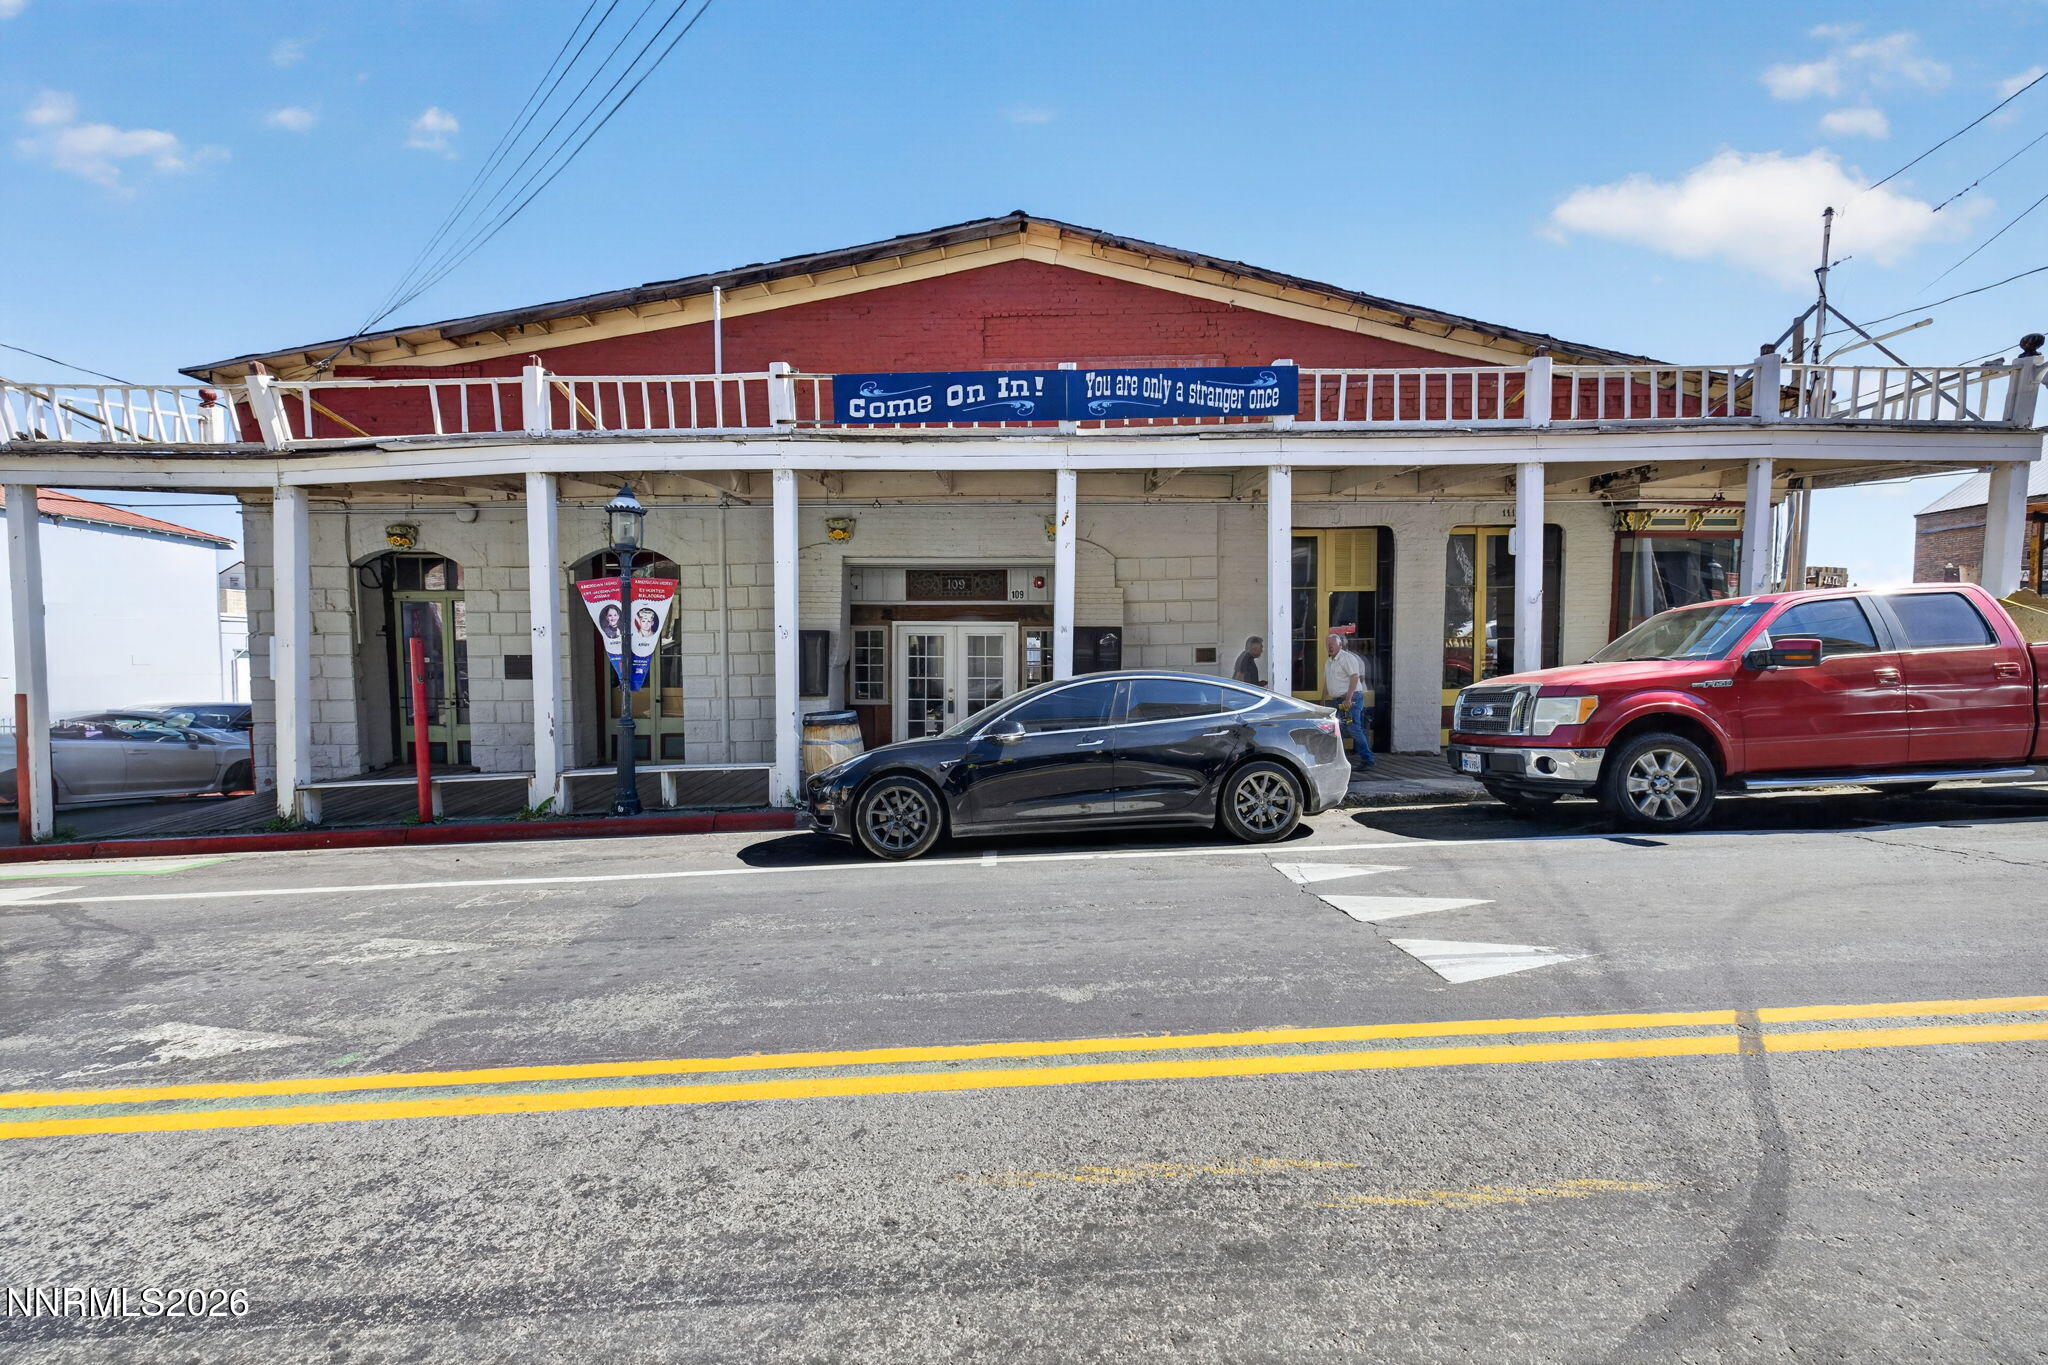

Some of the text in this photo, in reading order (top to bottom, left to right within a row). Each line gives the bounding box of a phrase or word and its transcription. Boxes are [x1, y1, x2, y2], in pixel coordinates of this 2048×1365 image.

[849, 376, 1044, 418] Come On In!
[1085, 372, 1280, 413] You are only a stranger once
[947, 578, 966, 590] 109
[1011, 590, 1024, 599] 109
